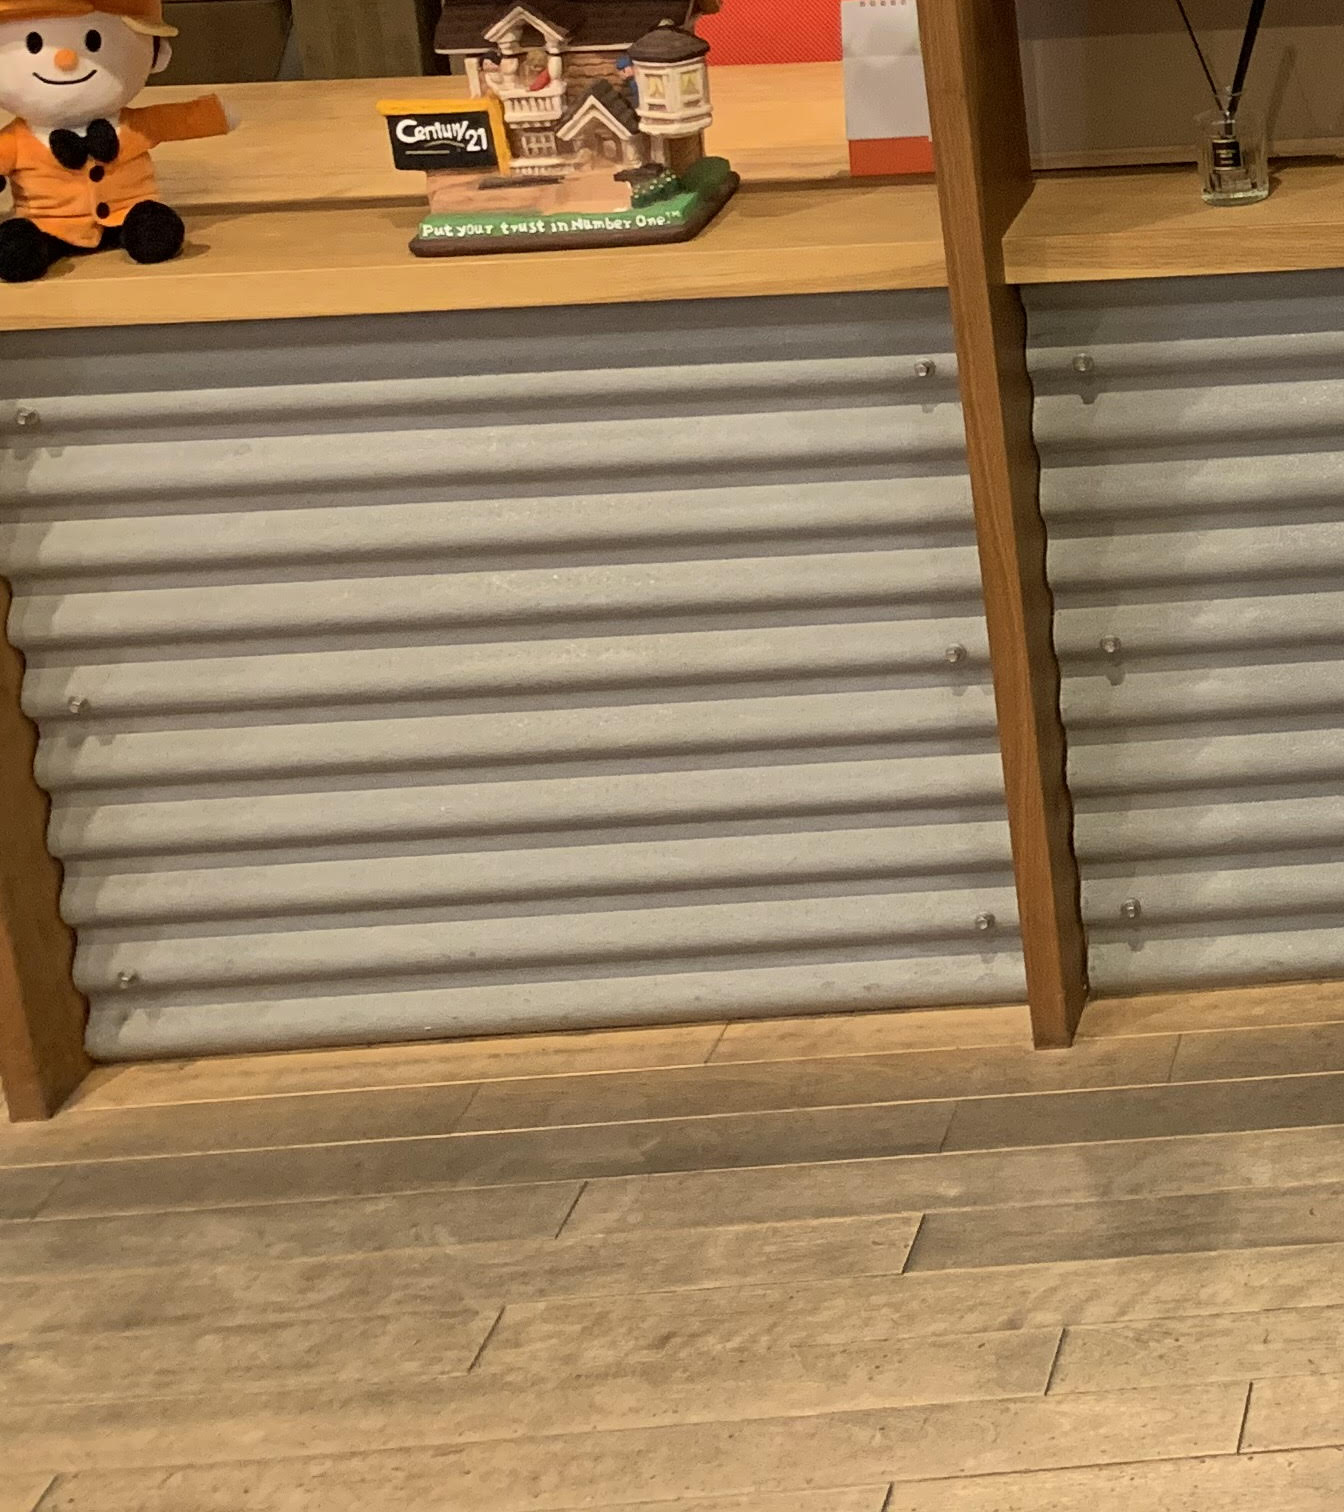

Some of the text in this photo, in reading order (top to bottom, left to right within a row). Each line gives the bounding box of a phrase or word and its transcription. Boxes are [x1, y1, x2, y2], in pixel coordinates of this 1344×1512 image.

[396, 118, 489, 152] Century 21
[421, 223, 453, 239] Put
[456, 221, 494, 238] your
[500, 219, 546, 235] trust
[550, 219, 569, 234] in
[566, 215, 632, 234] Number
